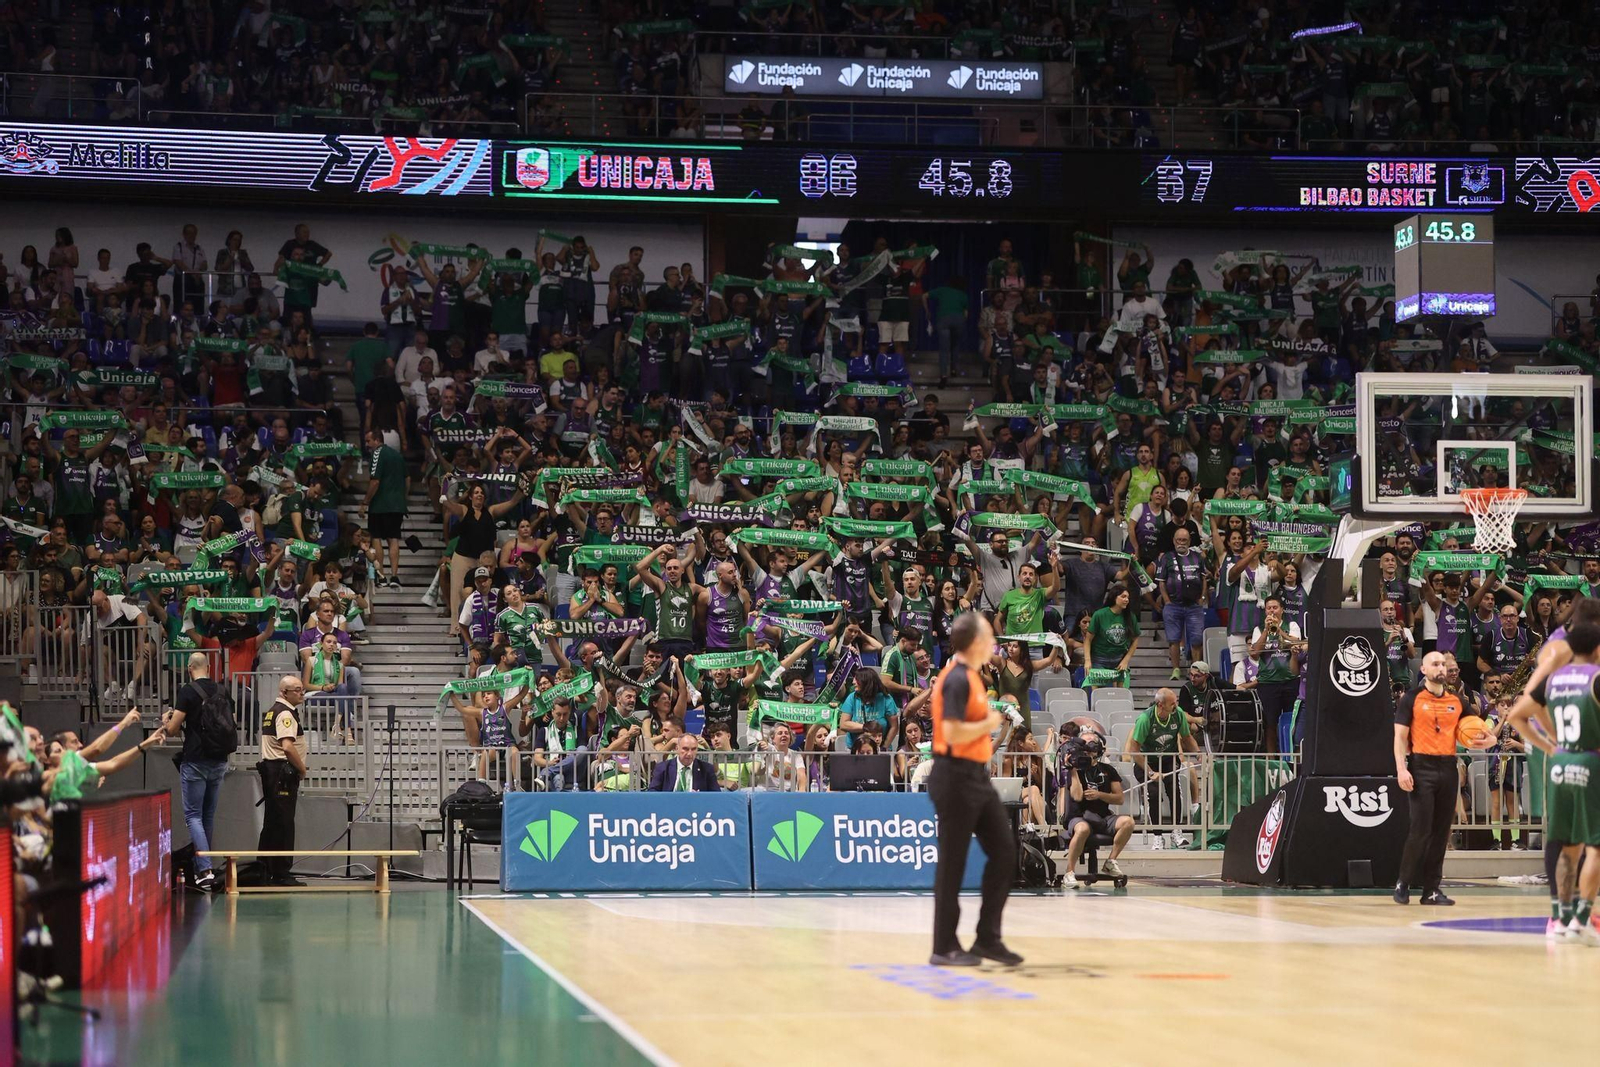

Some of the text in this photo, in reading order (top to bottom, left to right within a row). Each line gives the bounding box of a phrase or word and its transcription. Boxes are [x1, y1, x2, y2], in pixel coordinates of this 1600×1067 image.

[757, 62, 822, 77] Fundación
[866, 64, 931, 80] Fundación
[975, 66, 1039, 82] Fundación
[757, 74, 804, 89] Unicaja
[866, 76, 914, 92] Unicaja
[975, 78, 1021, 94] Unicaja
[68, 142, 171, 170] Melilla
[578, 154, 714, 191] UNICAJA
[800, 153, 857, 197] 86
[918, 158, 1013, 198] 45.8
[1366, 162, 1437, 185] SURNE
[1157, 159, 1213, 203] 67
[1300, 186, 1437, 207] BILBAO BASKET
[1395, 225, 1414, 251] 45.8
[1425, 221, 1476, 242] 45.8
[1448, 300, 1490, 315] Unicaja
[711, 323, 738, 333] Unicaja
[199, 337, 229, 347] Unicaja
[1272, 340, 1329, 353] UNICAJA
[100, 371, 156, 385] Unicaja
[852, 387, 888, 395] BALONCESTO
[990, 409, 1028, 417] BALONCESTO
[1061, 405, 1092, 414] Unicaja
[1219, 402, 1249, 415] Unicaja
[1254, 407, 1291, 415] BALONCESTO
[1289, 406, 1357, 420] Unicaja Baloncest
[72, 413, 107, 423] Unicaja
[1324, 420, 1353, 430] Unicaja
[437, 428, 498, 442] UNICAJ
[309, 441, 342, 451] Unicaja
[760, 461, 793, 469] Unicaja
[880, 462, 912, 470] Unicaja
[174, 473, 209, 483] Unicaja
[568, 472, 638, 484] UNICAJA
[1036, 475, 1068, 487] Unicaja
[596, 488, 630, 496] Unicaja
[875, 486, 907, 495] Unicaja
[1379, 483, 1390, 491] liga
[688, 503, 764, 520] UNICAJA
[1218, 501, 1250, 509] Unicaja
[623, 526, 696, 543] UNICAJA
[1281, 522, 1323, 534] BALONCESTO
[770, 531, 804, 539] Unicaja
[1273, 536, 1303, 544] UNICAJA
[609, 546, 645, 556] Unicaja
[901, 550, 917, 559] TAU
[1443, 554, 1477, 563] Unicaja
[212, 597, 249, 606] Unicaja
[562, 619, 640, 634] UNICAJA
[671, 616, 686, 628] 10
[721, 624, 735, 634] 45
[700, 657, 738, 666] Unicaja
[1337, 669, 1371, 685] Risi
[457, 679, 498, 690] Unicaja
[776, 704, 815, 715] Unicaja
[1555, 705, 1581, 742] 13
[1323, 784, 1392, 821] Risi
[588, 812, 736, 838] Fundación
[833, 813, 939, 839] Fundaci
[588, 838, 696, 870] Unicaja
[1257, 838, 1274, 858] Risi
[834, 839, 939, 871] Unicaja
